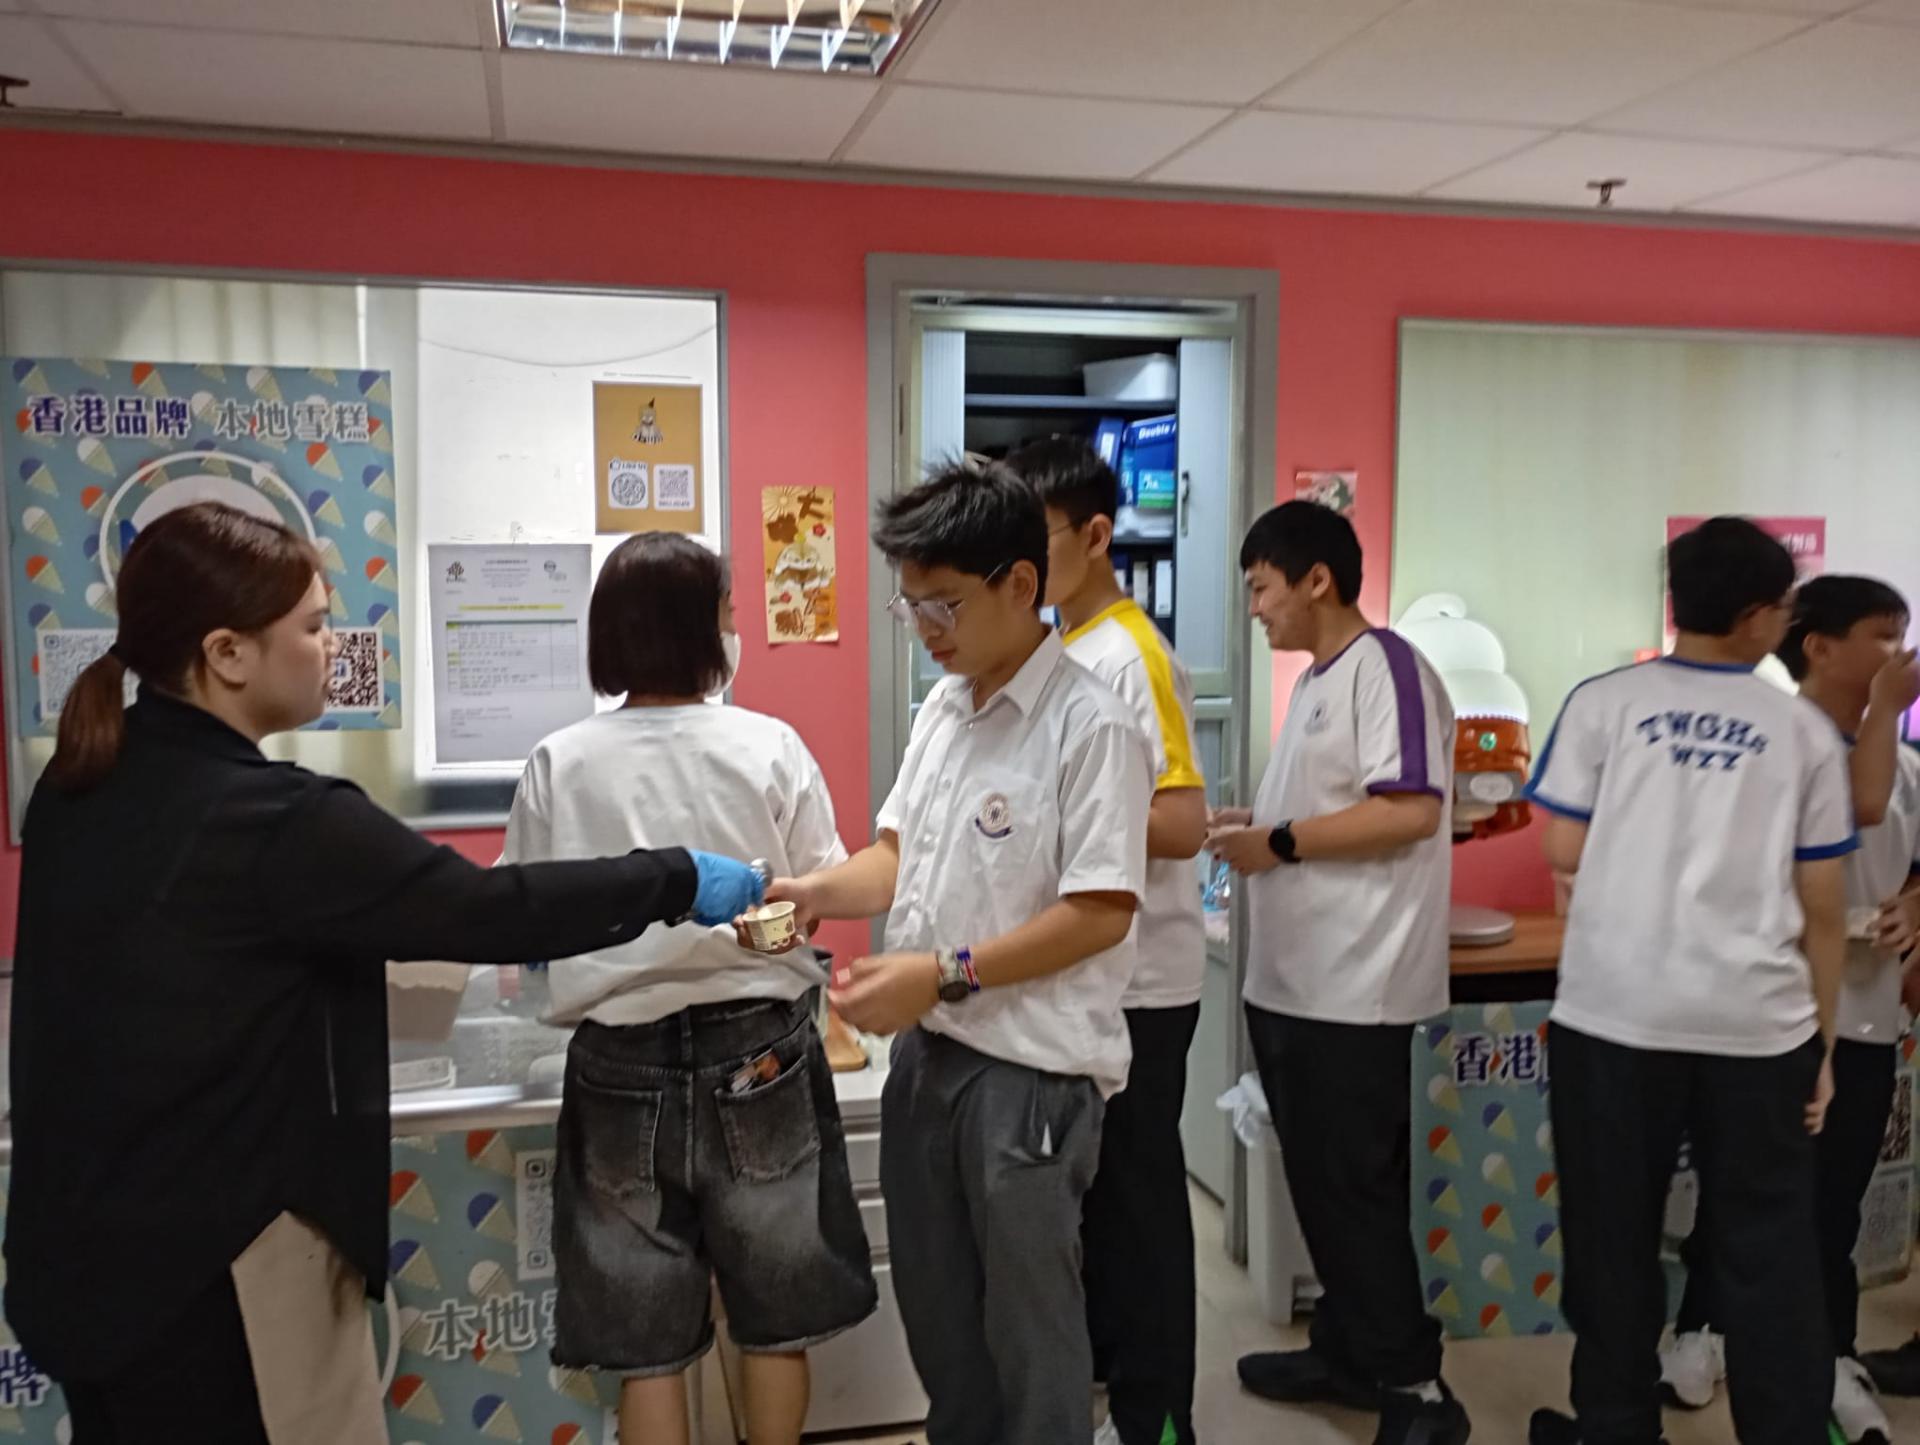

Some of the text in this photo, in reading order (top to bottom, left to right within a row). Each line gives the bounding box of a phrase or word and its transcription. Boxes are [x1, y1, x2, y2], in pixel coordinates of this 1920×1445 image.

[28, 394, 369, 442] 香港品牌 本地雪糕
[1139, 424, 1170, 439] Double
[1453, 1034, 1547, 1084] 香港
[421, 1290, 556, 1359] 本地
